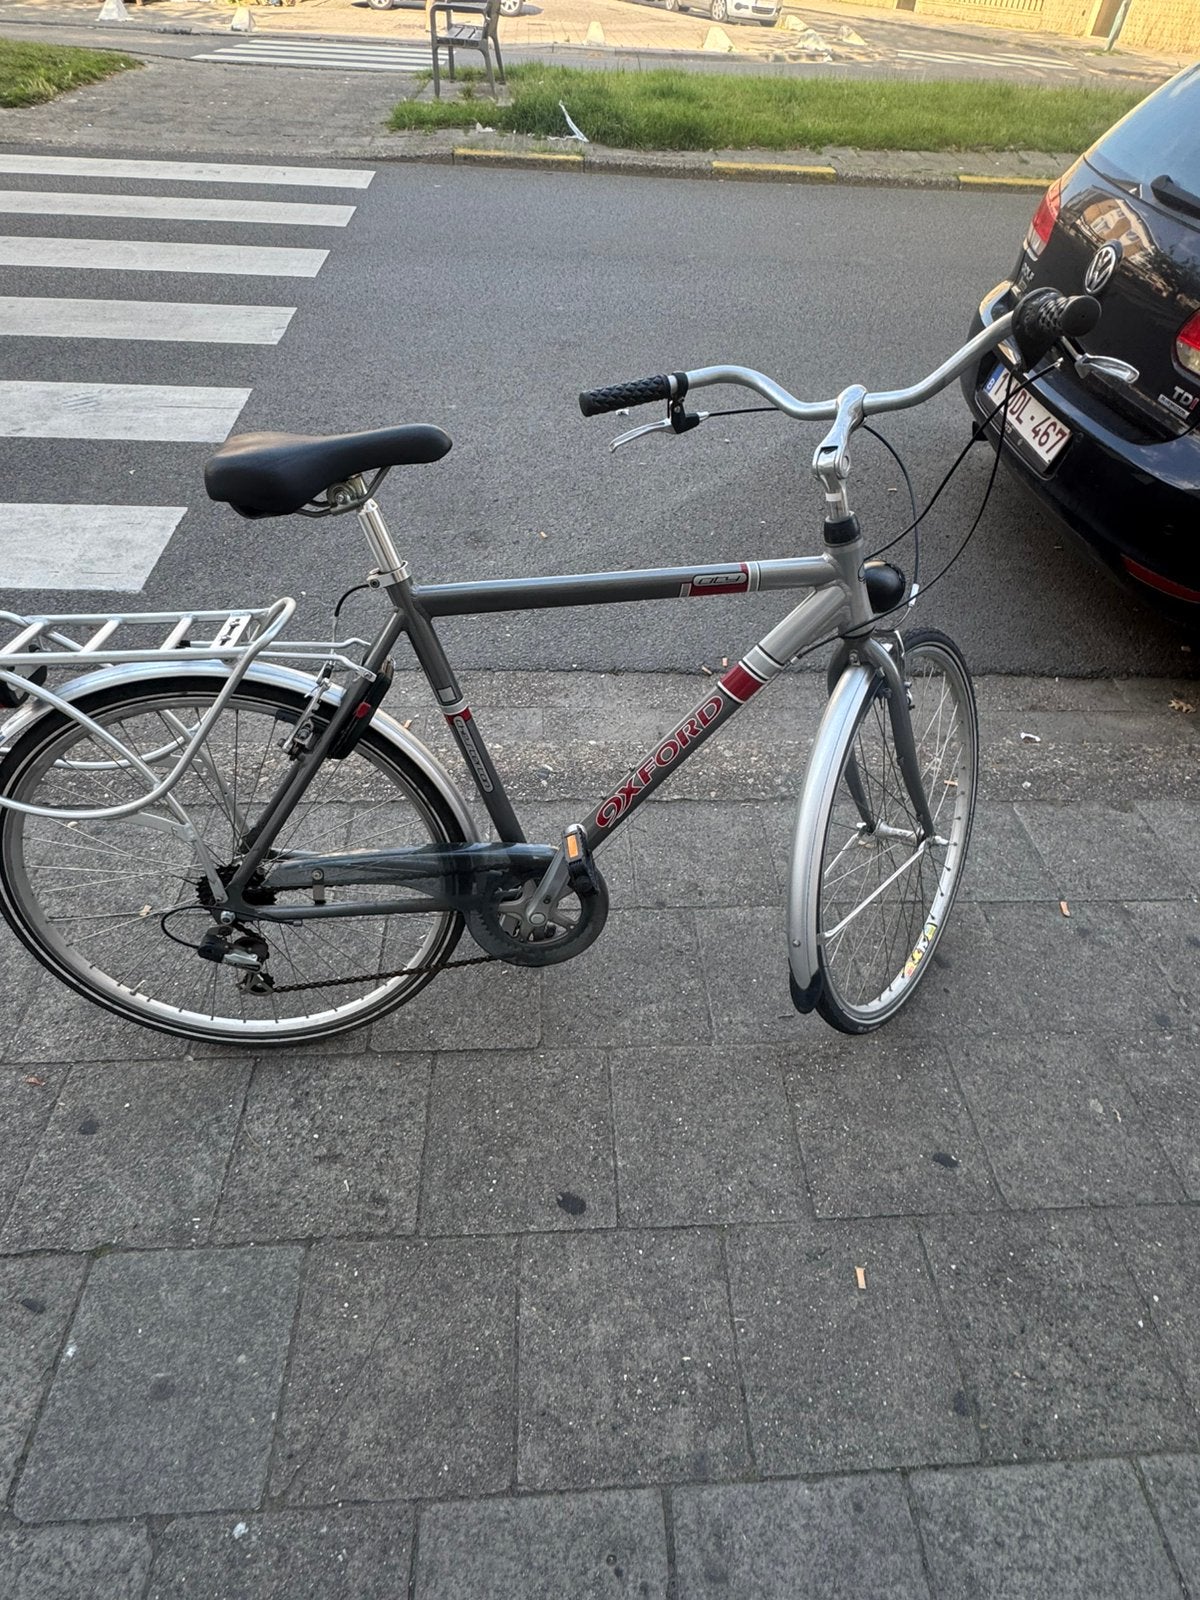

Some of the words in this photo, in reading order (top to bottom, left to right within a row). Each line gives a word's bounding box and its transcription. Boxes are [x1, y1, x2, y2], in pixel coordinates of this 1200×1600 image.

[986, 378, 995, 390] B
[1172, 385, 1200, 411] TDI
[595, 695, 724, 828] OXFORD
